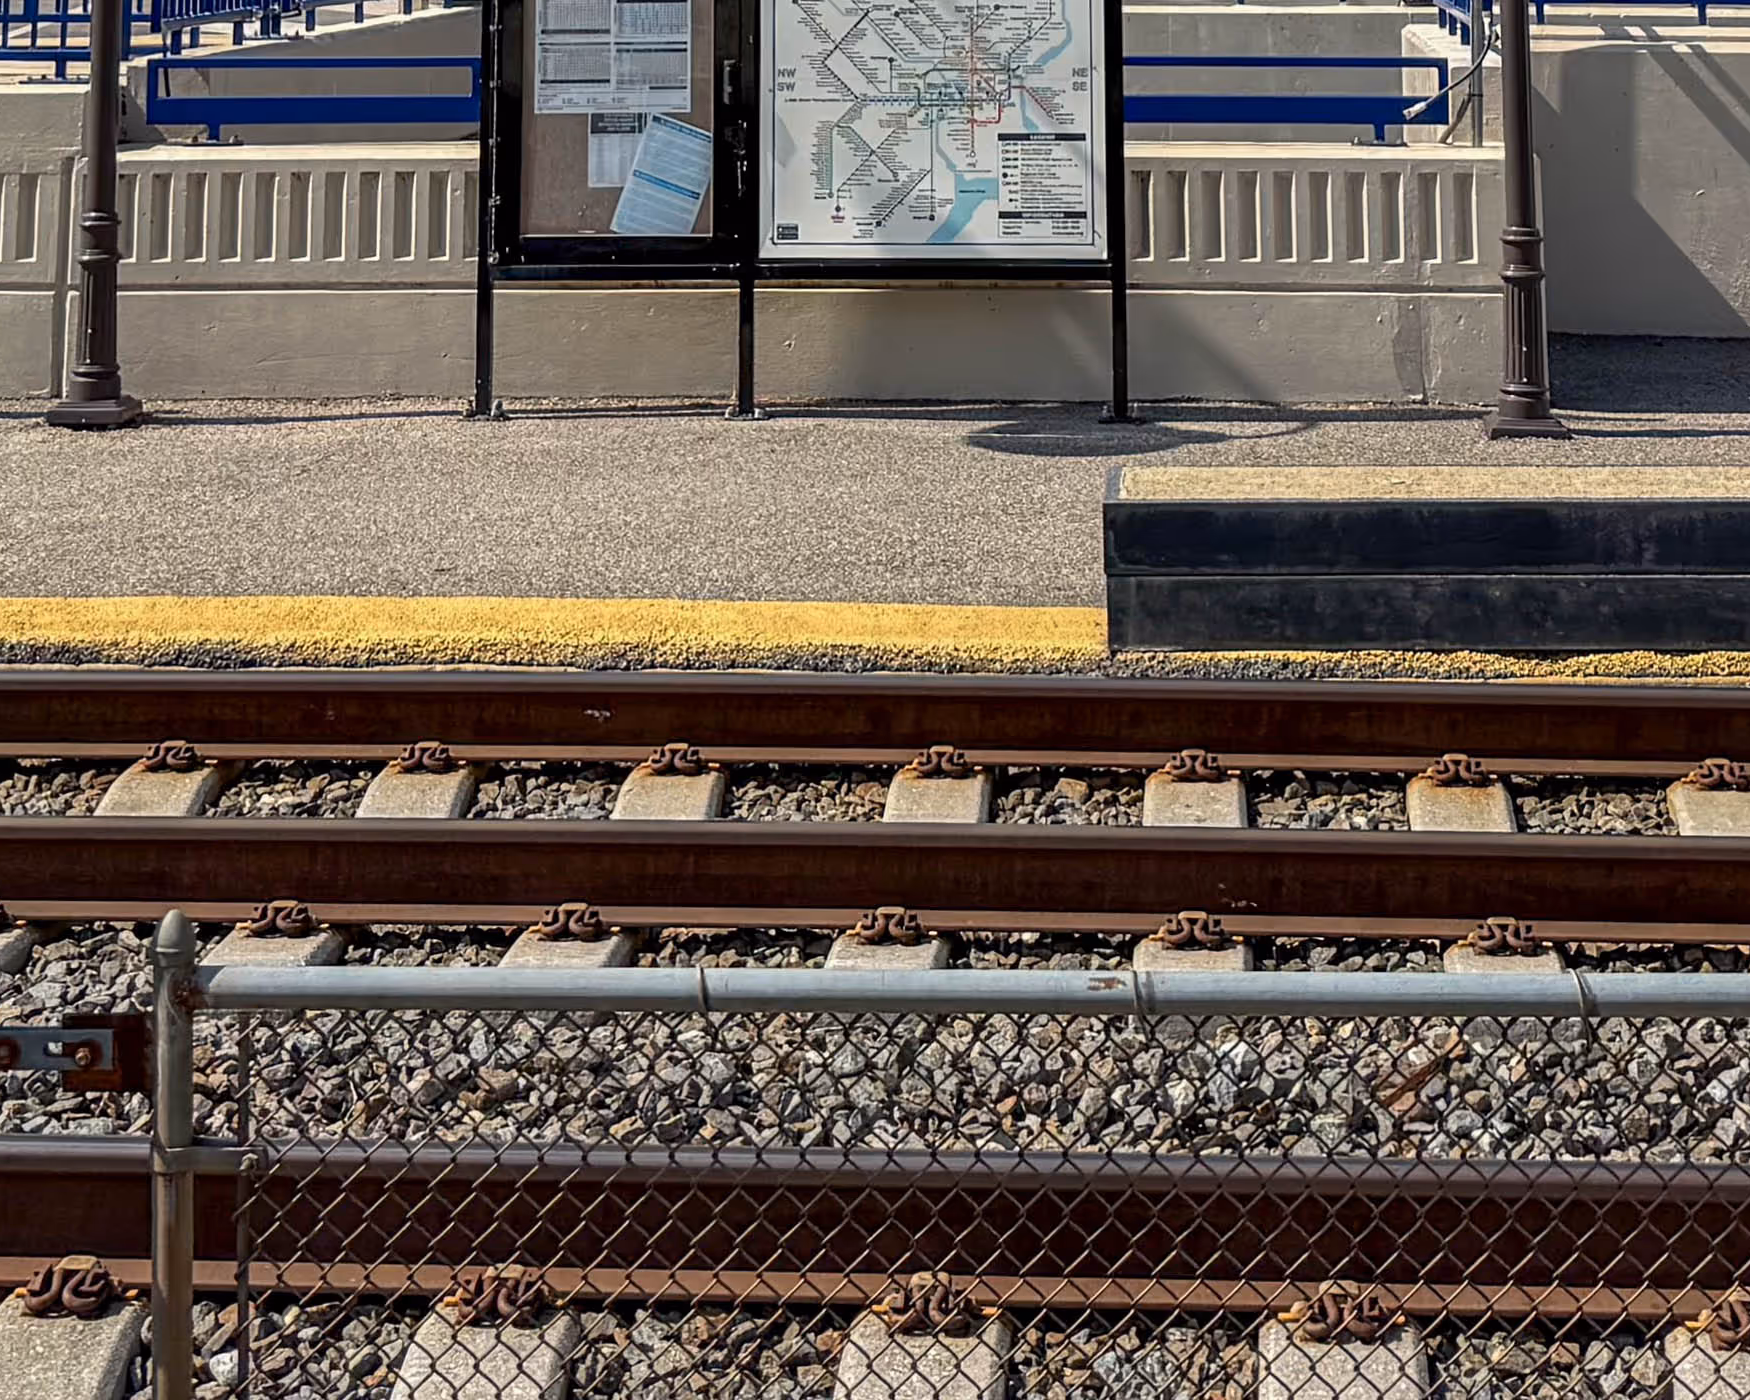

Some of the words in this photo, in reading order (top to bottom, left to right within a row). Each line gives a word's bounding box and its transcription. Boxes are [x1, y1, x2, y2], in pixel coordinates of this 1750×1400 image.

[777, 68, 797, 78] NW
[1072, 68, 1088, 78] NE
[777, 82, 796, 92] SW
